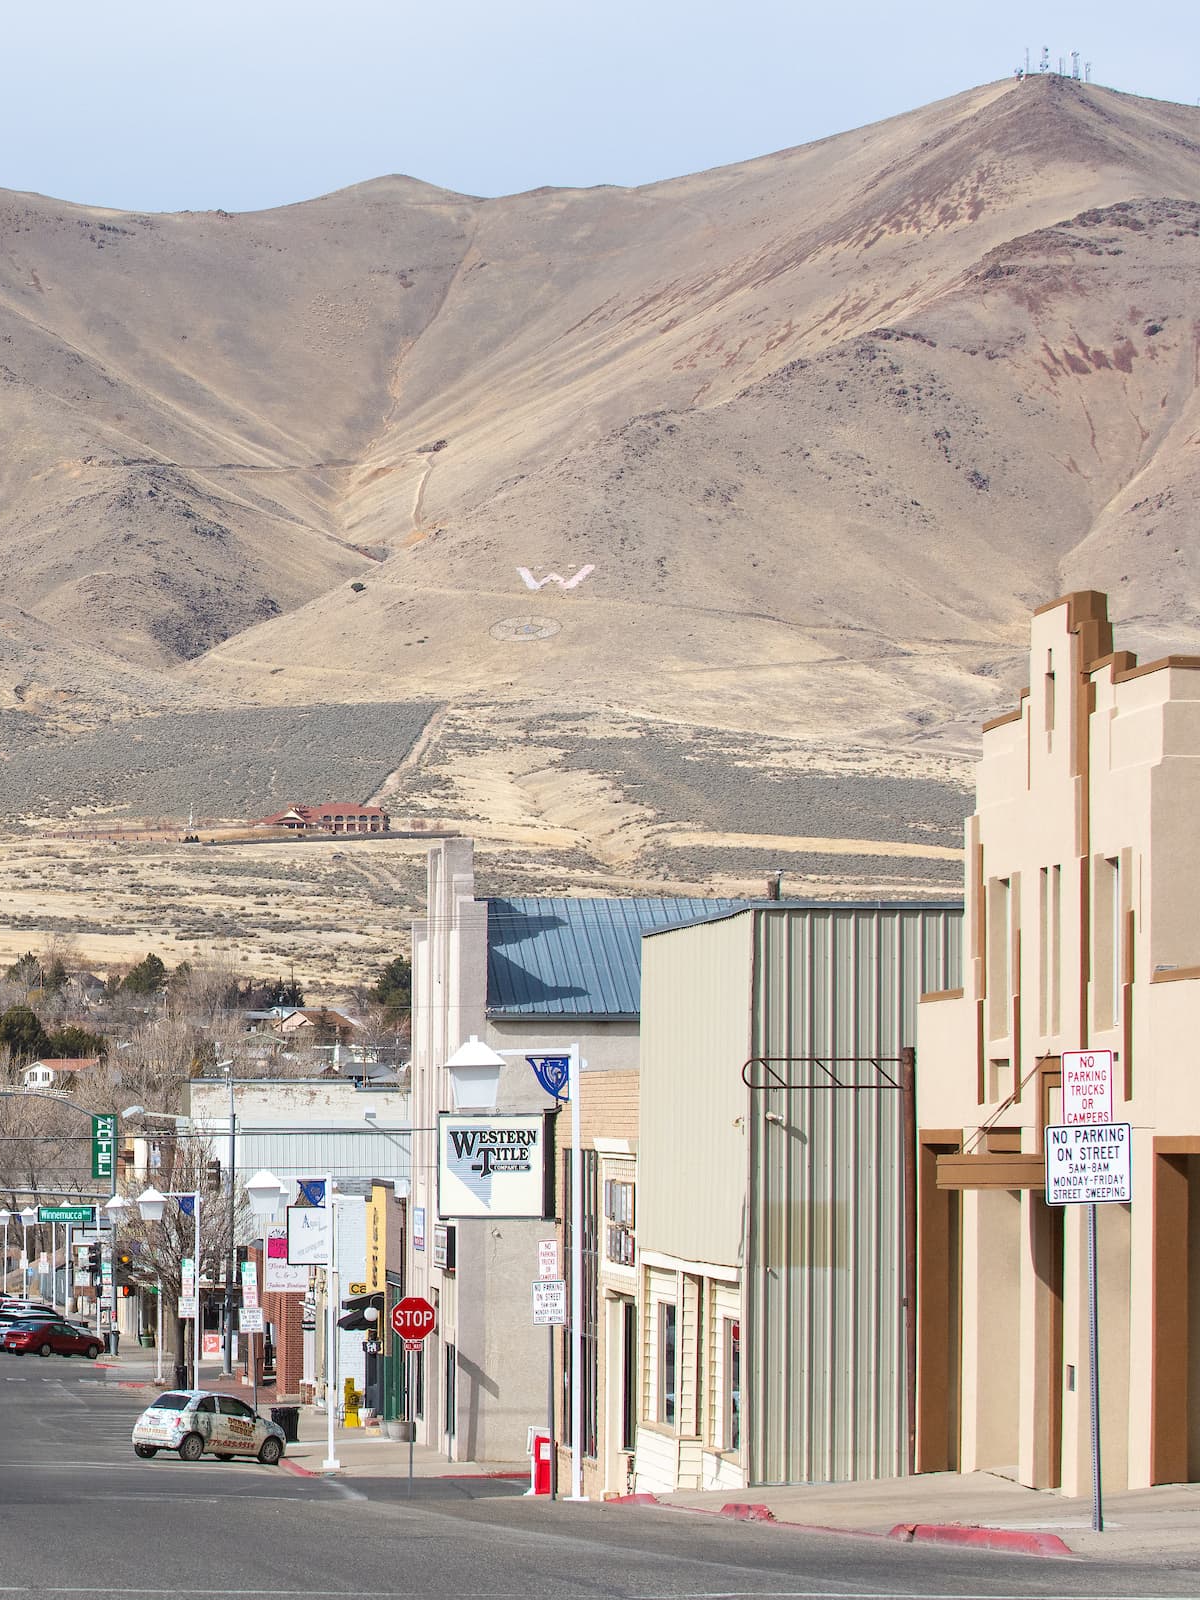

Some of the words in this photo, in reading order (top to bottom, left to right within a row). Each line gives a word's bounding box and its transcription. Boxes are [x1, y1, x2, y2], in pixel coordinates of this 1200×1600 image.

[516, 565, 595, 590] W
[1079, 1056, 1095, 1068] NO
[1068, 1070, 1107, 1083] PARKING
[1070, 1084, 1105, 1096] TRUCKS
[1081, 1098, 1094, 1110] OR
[1067, 1111, 1109, 1124] CAMPERS
[1052, 1130, 1068, 1145] NO
[1075, 1128, 1125, 1144] PARKING
[449, 1130, 537, 1159] WESTERN
[1057, 1148, 1072, 1162] ON
[1079, 1146, 1120, 1161] STREET
[476, 1147, 529, 1178] TITLE
[1068, 1162, 1110, 1174] 5AM-8AM
[1053, 1174, 1125, 1187] MONDAY-FRIDAY
[1053, 1188, 1081, 1200] STREET
[1085, 1187, 1126, 1199] SWEEPING
[41, 1209, 82, 1220] Winnemucca
[351, 1284, 367, 1294] Ca
[543, 1283, 563, 1291] PARKING
[536, 1293, 543, 1301] ON
[394, 1310, 433, 1327] STOP
